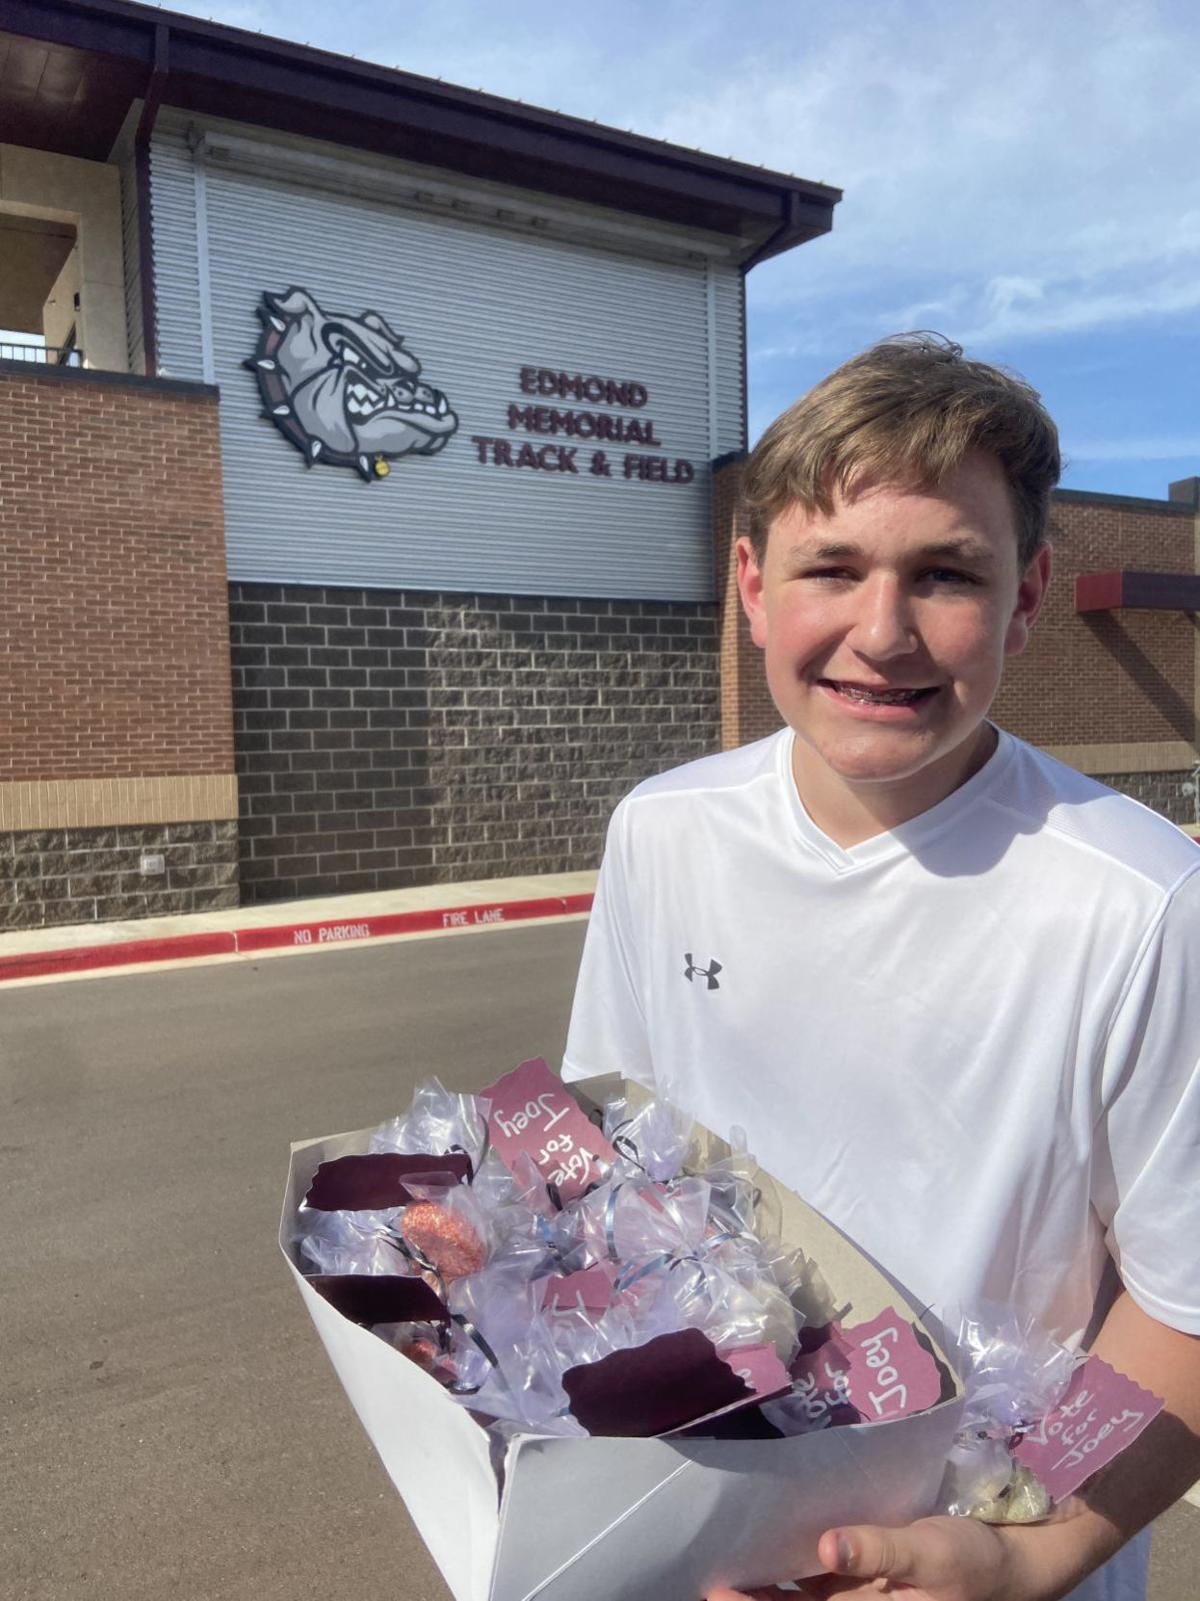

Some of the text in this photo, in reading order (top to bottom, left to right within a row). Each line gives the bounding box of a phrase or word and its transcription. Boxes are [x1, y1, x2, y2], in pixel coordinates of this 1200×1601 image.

[520, 366, 648, 408] EDMOND
[507, 403, 661, 447] MEMORIAL
[471, 435, 695, 484] TRACK & FIELD
[293, 923, 370, 945] NO PARKING
[442, 908, 505, 928] FIRE LANE
[493, 1093, 571, 1138] Joey
[538, 1134, 574, 1165] for
[546, 1146, 594, 1187] Vote
[860, 1326, 908, 1415] Joey
[1024, 1389, 1095, 1446] Vote
[1051, 1409, 1144, 1471] Joey
